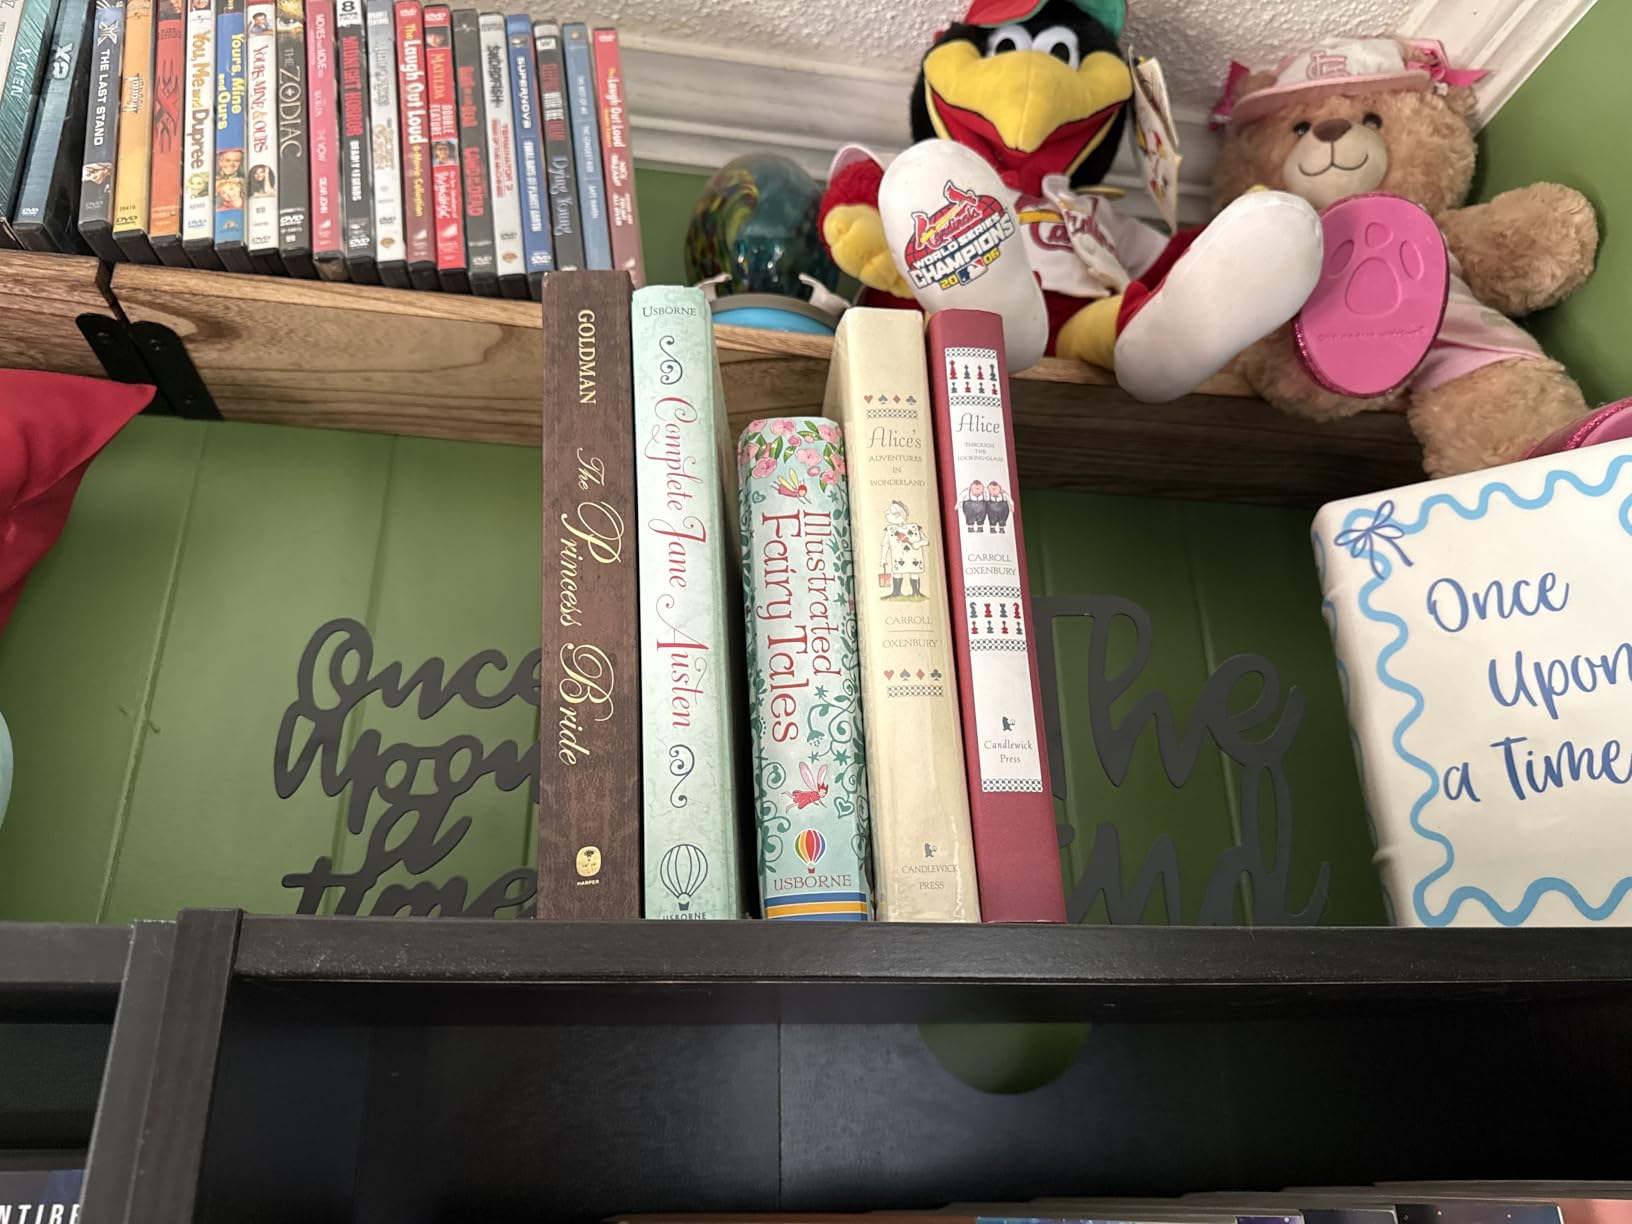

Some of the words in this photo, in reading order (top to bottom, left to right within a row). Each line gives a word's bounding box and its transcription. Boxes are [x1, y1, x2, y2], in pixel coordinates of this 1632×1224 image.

[342, 1, 356, 12] 8
[404, 23, 416, 40] The
[100, 48, 111, 71] THE
[231, 33, 245, 76] Yours,
[284, 48, 295, 67] THE
[342, 36, 361, 90] MIDNIGHT
[400, 40, 424, 80] Laugh
[12, 48, 31, 97] X-MEN
[97, 73, 109, 104] LAST
[193, 62, 210, 87] Me
[430, 53, 445, 100] MATILDA
[487, 45, 504, 106] SWORDFISH
[192, 88, 203, 108] and
[231, 77, 245, 115] Mine
[406, 83, 425, 107] Out
[516, 56, 531, 129] SUPERNOVA
[605, 78, 619, 108] Laugh
[93, 105, 106, 146] STAND
[217, 91, 230, 130] Ours
[252, 110, 263, 121] &
[279, 67, 303, 158] ZODIAC
[344, 91, 363, 136] HORROR
[407, 110, 428, 144] Loud
[430, 104, 444, 136] FEATURE
[442, 103, 455, 133] DOUBLE
[611, 107, 622, 125] Out
[187, 109, 210, 169] Dupree
[253, 120, 269, 153] OURS
[613, 126, 627, 147] Loud
[350, 140, 360, 169] DEADLY
[319, 176, 328, 195] DEAR
[548, 157, 569, 195] Dying
[320, 195, 328, 214] JOHN
[553, 196, 574, 236] Young
[909, 212, 1015, 289] CHAMPIONS
[912, 241, 960, 270] WORLD
[642, 305, 697, 317] USBORNE
[577, 309, 596, 405] GOLDMAN
[867, 425, 922, 450] Alice's
[955, 412, 1001, 434] Alice
[644, 396, 704, 511] Complete
[964, 441, 996, 449] THROUGH
[576, 447, 605, 491] The
[560, 501, 625, 627] Princess
[647, 515, 707, 589] Jane
[755, 509, 802, 621] Fairy
[967, 553, 1011, 562] CARROLL
[965, 566, 1017, 576] OXENBURY
[802, 509, 843, 677] Illustrated
[1426, 572, 1570, 633] Once
[884, 615, 933, 625] CARROLL
[882, 638, 938, 649] OXENBURY
[656, 593, 709, 728] Austen
[767, 624, 810, 744] Tales
[1488, 642, 1632, 720] Upon
[559, 642, 615, 766] Bride
[984, 739, 1033, 751] Candlewick
[999, 753, 1021, 763] Press
[1443, 761, 1482, 803] a
[1490, 736, 1632, 801] Time
[1058, 763, 1332, 926] nd
[773, 874, 852, 891] USBORNE
[901, 864, 959, 874] CANDLEWICK
[919, 880, 945, 889] PRESS
